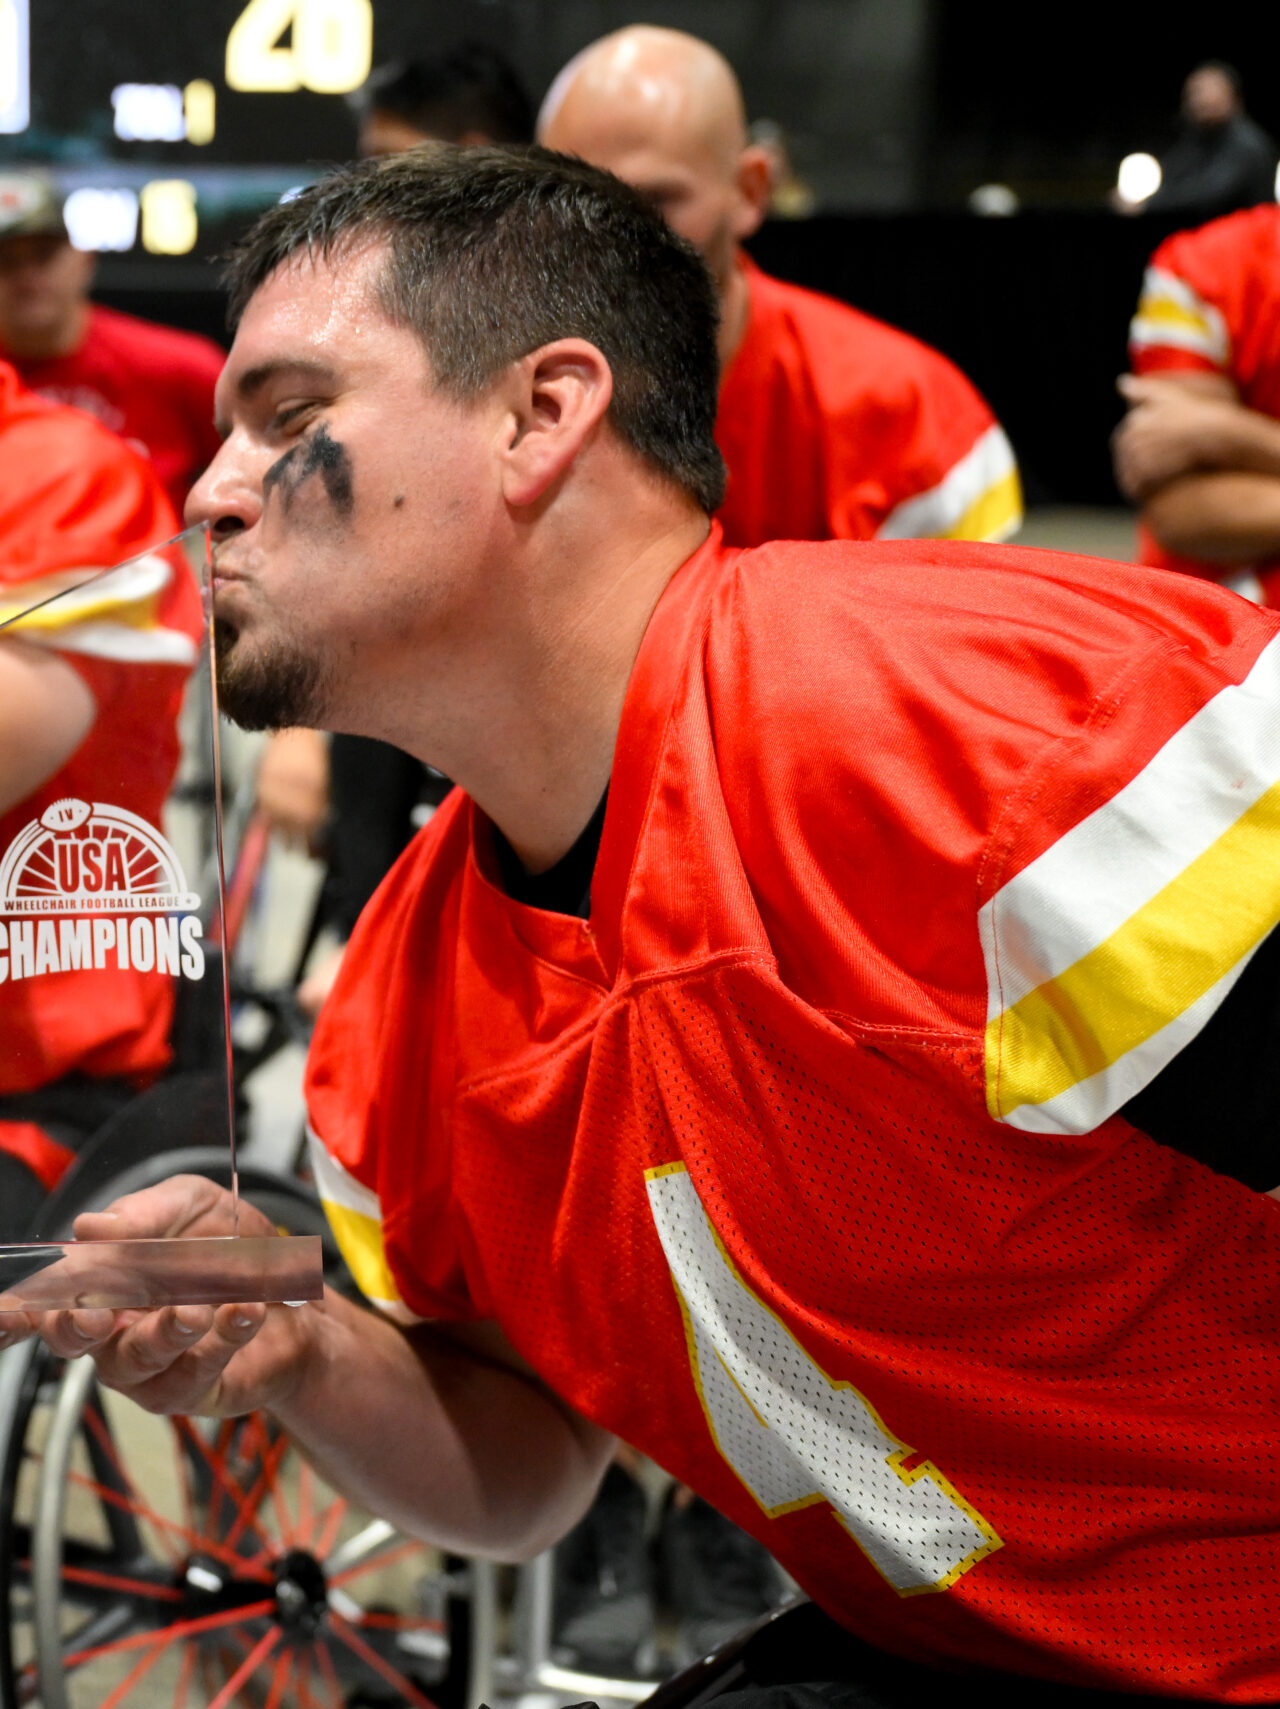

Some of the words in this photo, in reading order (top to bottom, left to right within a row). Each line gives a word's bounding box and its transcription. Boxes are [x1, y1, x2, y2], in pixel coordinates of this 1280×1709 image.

[57, 807, 74, 823] IV
[57, 842, 128, 893] USA
[4, 898, 78, 911] WHEELCHAIR
[80, 897, 135, 910] FOOTBALL
[138, 896, 180, 909] LEAGUE
